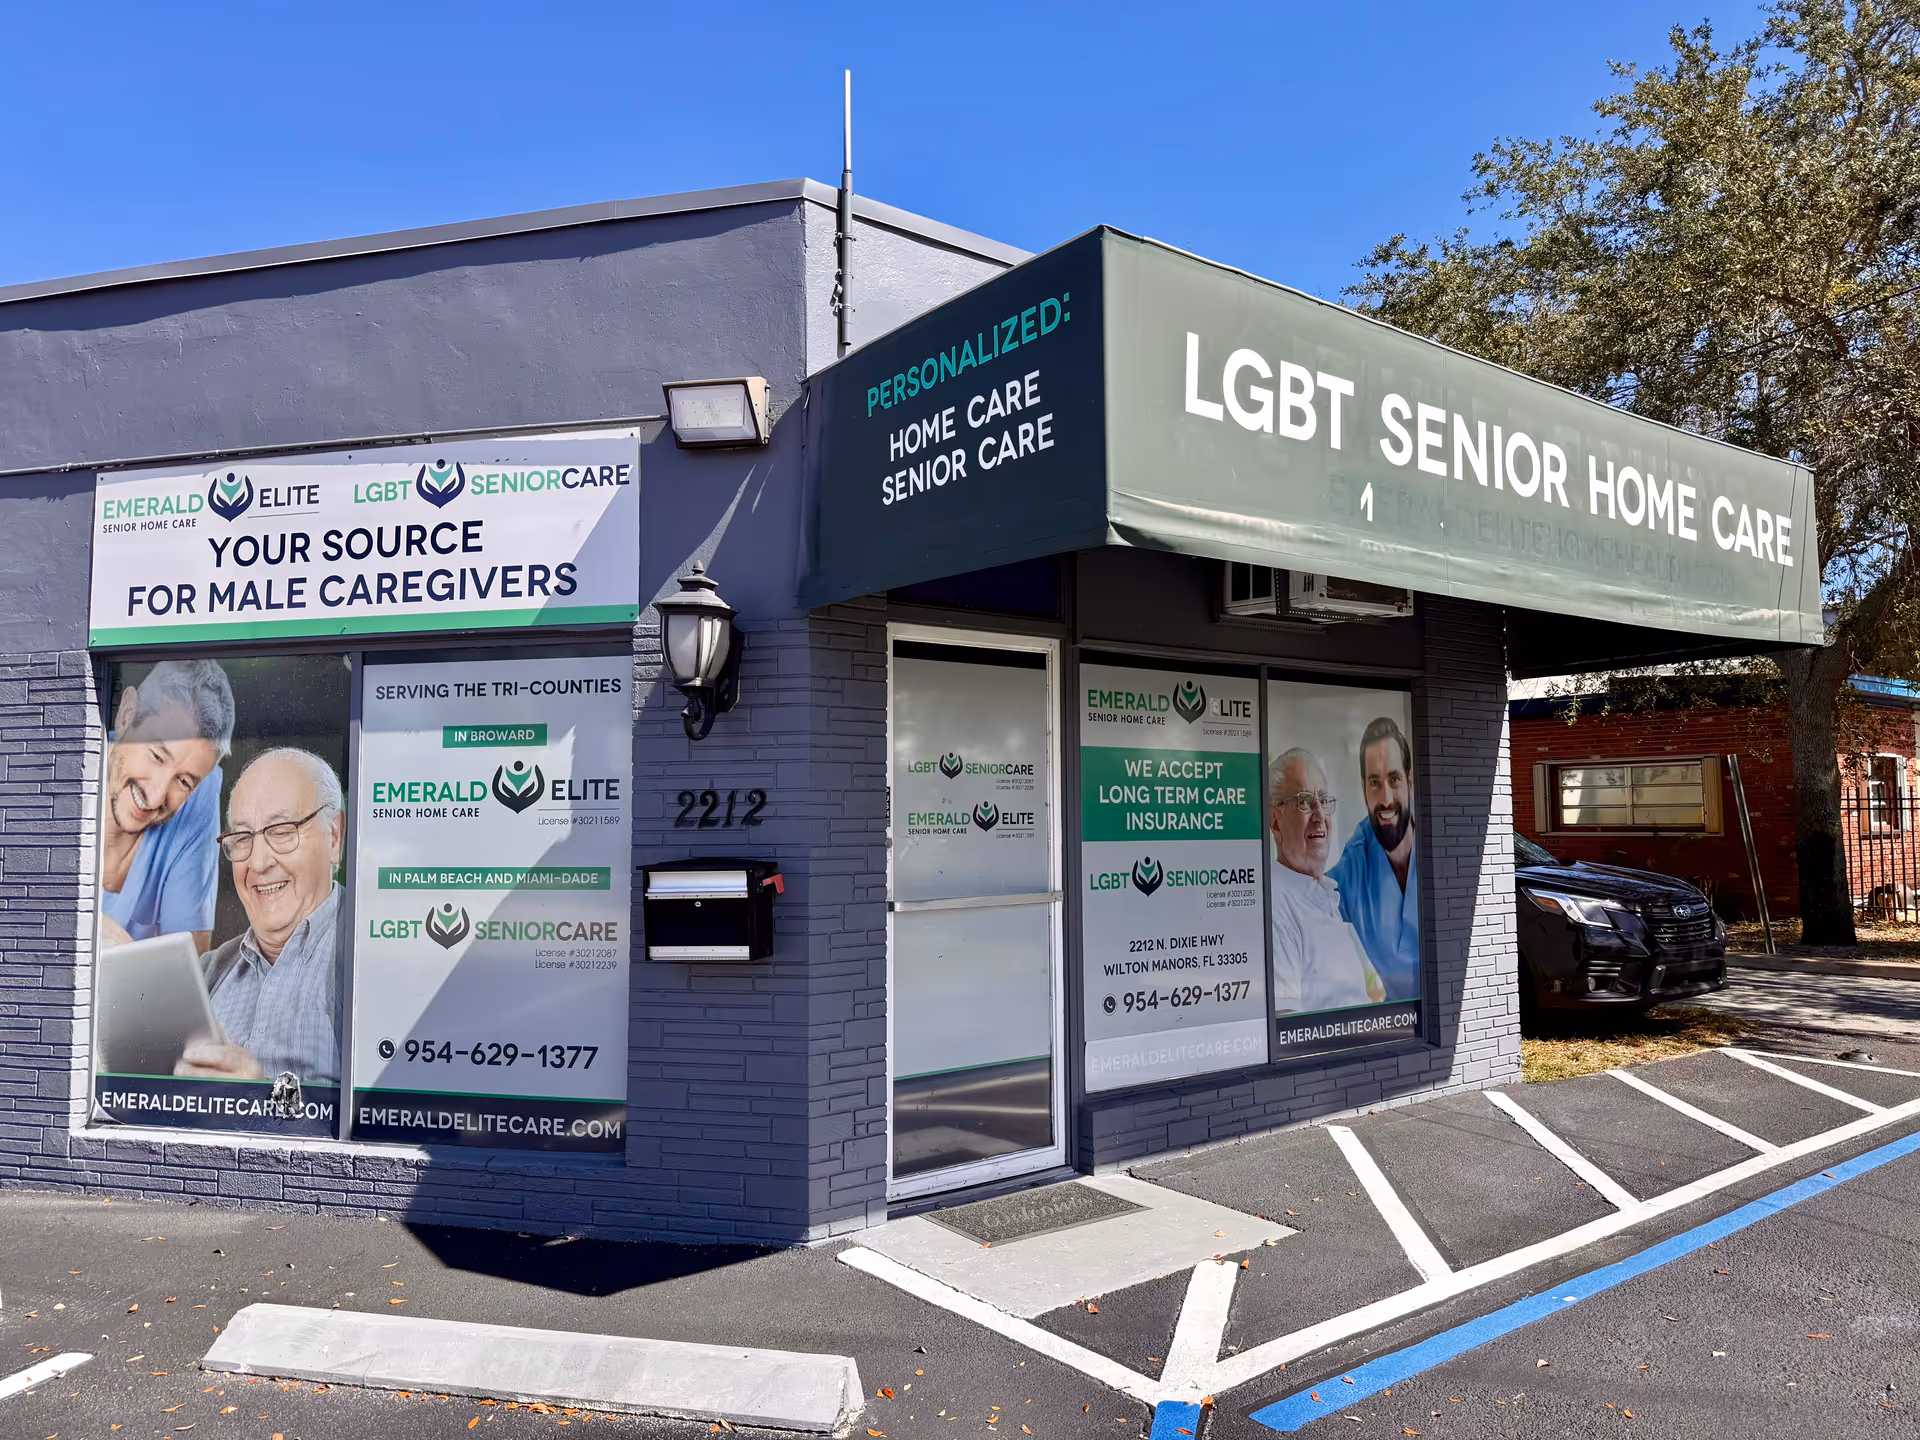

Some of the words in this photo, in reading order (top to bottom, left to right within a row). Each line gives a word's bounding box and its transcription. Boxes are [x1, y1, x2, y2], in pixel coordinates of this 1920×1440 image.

[867, 291, 1070, 418] PERSONALIZED:
[890, 406, 956, 462] HOME
[967, 369, 1041, 428] CARE
[882, 448, 967, 506] SENIOR
[978, 412, 1055, 470] CARE
[1185, 331, 1355, 450] LGBT
[1379, 392, 1570, 508] SENIOR
[1588, 454, 1698, 542] HOME
[1711, 495, 1794, 568] CARE
[354, 480, 412, 503] LGBT
[470, 464, 630, 495] SENIORCARE
[103, 493, 204, 519] EMERALD
[259, 484, 319, 508] ELITE
[103, 523, 137, 533] SENIOR
[141, 520, 168, 531] HOME
[172, 518, 197, 529] CARE
[208, 532, 310, 568] YOUR
[321, 520, 483, 560] SOURCE
[128, 583, 196, 616] FOR
[208, 577, 307, 613] MALE
[319, 562, 578, 606] CAREGIVERS
[375, 683, 449, 700] SERVING
[454, 682, 487, 698] THE
[492, 678, 622, 697] TRI-COUNTIES
[1087, 689, 1170, 712] EMERALD
[1088, 713, 1118, 723] SENIOR
[1120, 714, 1144, 724] HOME
[1146, 715, 1166, 725] CARE
[454, 730, 467, 742] IN
[470, 729, 535, 742] BROWARD
[908, 761, 938, 773] LGBT
[965, 763, 1034, 775] SENIORCARE
[1125, 759, 1152, 778] WE
[1157, 761, 1224, 779] ACCEPT
[373, 781, 488, 803] EMERALD
[551, 778, 620, 801] ELITE
[1099, 785, 1150, 804] LONG
[1154, 786, 1199, 804] TERM
[1203, 787, 1246, 805] CARE
[372, 808, 412, 819] SENIOR
[415, 808, 447, 818] HOME
[451, 808, 480, 817] CARE
[674, 788, 768, 828] 2212
[908, 812, 971, 826] EMERALD
[1002, 812, 1034, 825] ELITE
[538, 816, 569, 826] License
[571, 816, 620, 825] #30211589
[1126, 812, 1224, 830] INSURANCE
[389, 873, 401, 884] IN
[404, 873, 437, 884] PALM
[440, 873, 482, 884] BEACH
[485, 873, 513, 884] AND
[516, 872, 598, 884] MIAMI-DADE
[1090, 872, 1130, 891] LGBT
[1166, 868, 1255, 888] SENIORCARE
[369, 919, 422, 939] LGBT
[475, 921, 618, 942] SENIORCARE
[535, 948, 566, 958] License
[568, 948, 617, 958] #30212087
[1129, 939, 1154, 953] 2212
[1156, 938, 1167, 950] N.
[1170, 936, 1198, 949] DIXIE
[1200, 934, 1225, 947] HWY
[535, 960, 566, 969] License
[568, 960, 617, 970] #30212239
[1103, 961, 1149, 976] WILTON
[1152, 957, 1201, 972] MANORS,
[1203, 955, 1215, 967] FL
[1217, 952, 1248, 966] 33305
[1123, 980, 1250, 1013] 954-629-1377
[1280, 1012, 1417, 1045] EMERALDELITECARE.COM
[404, 1039, 599, 1069] 954-629-1377
[102, 1091, 334, 1121] EMERALDELITECARCOM
[359, 1107, 621, 1139] EMERALDELITECARE.COM
